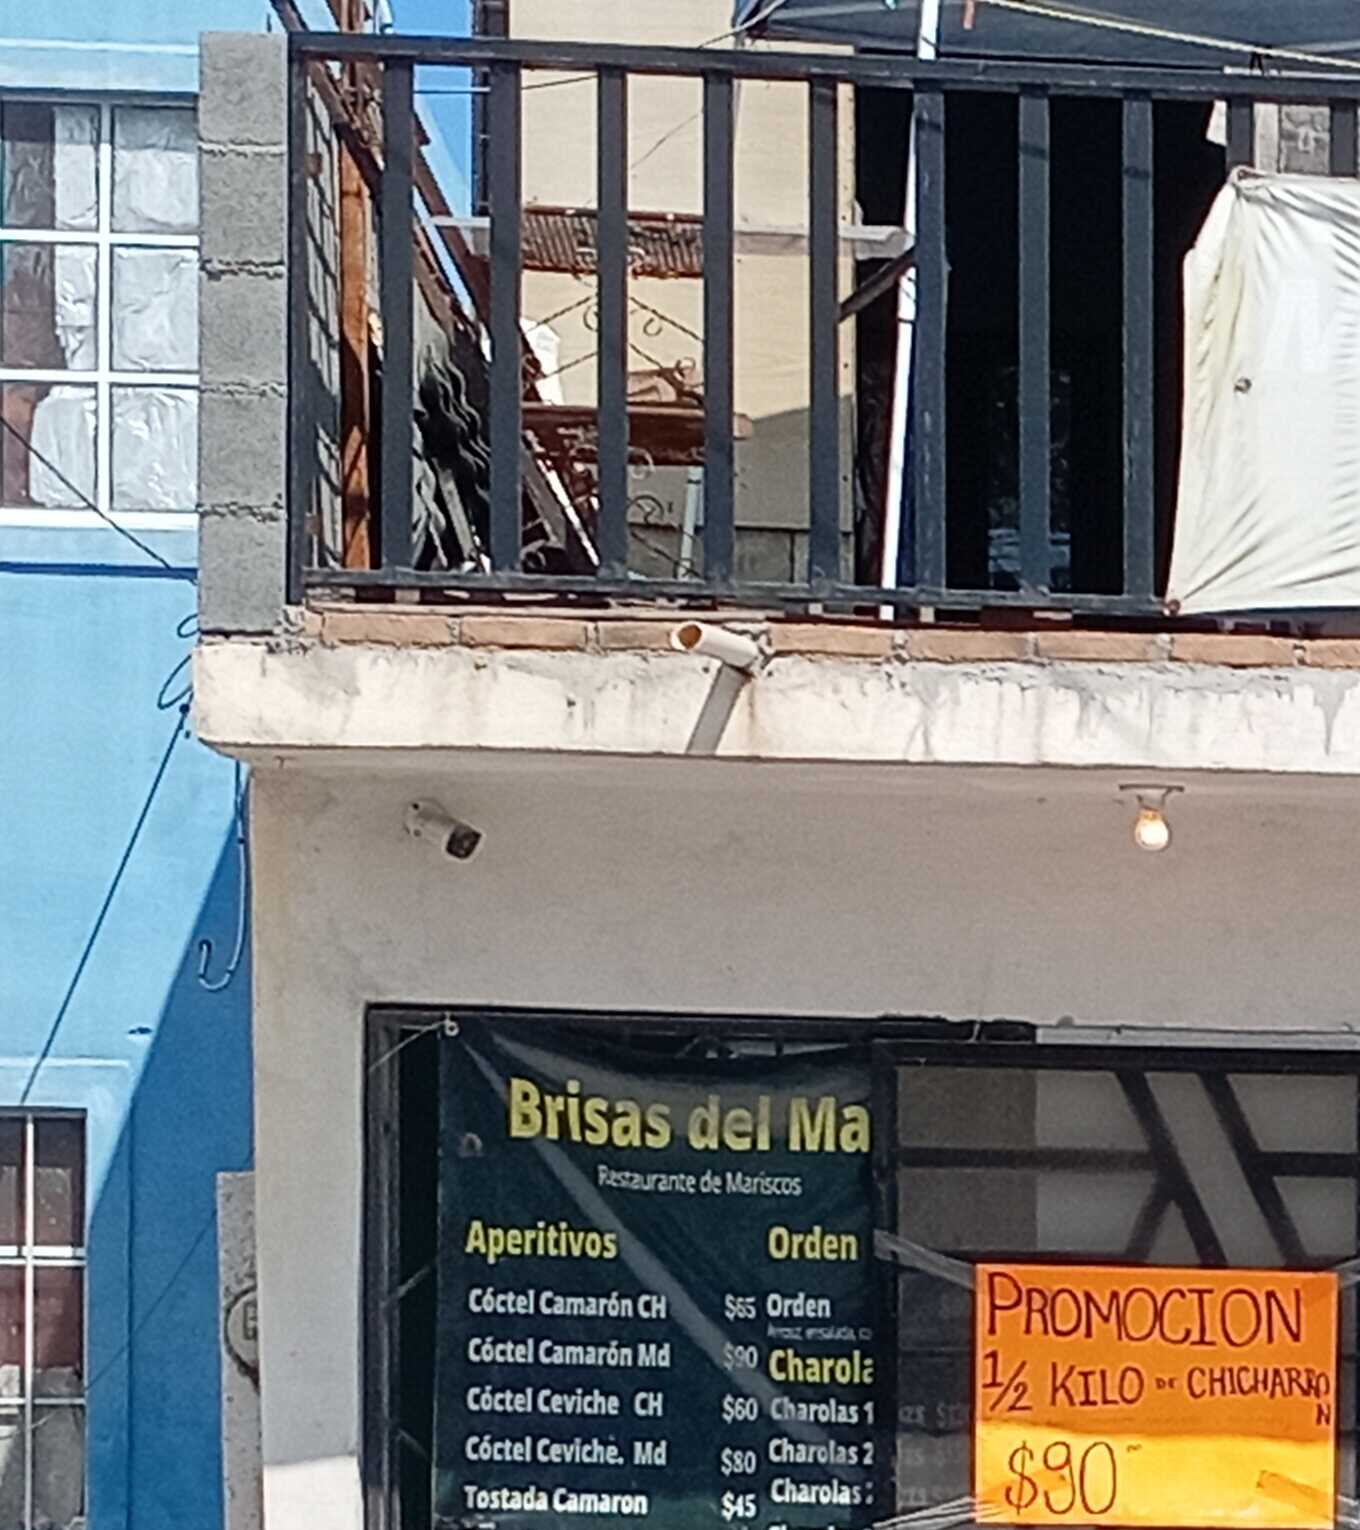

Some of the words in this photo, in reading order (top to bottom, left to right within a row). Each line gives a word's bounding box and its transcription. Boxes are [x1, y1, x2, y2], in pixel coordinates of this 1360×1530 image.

[509, 1077, 671, 1147] Brisas
[688, 1094, 769, 1150] del
[599, 1165, 695, 1193] Restaurante
[700, 1168, 721, 1193] de
[727, 1170, 801, 1196] Mariscos
[466, 1221, 617, 1264] Aperitivos
[769, 1227, 857, 1260] Orden
[469, 1289, 534, 1315] Cóctel
[539, 1291, 633, 1318] Camarón
[638, 1295, 666, 1319] CH
[725, 1293, 756, 1321] $65
[766, 1292, 831, 1318] Orden
[988, 1272, 1300, 1347] PROMOCION
[469, 1338, 534, 1364] Cóctel
[539, 1341, 632, 1367] Camarón
[639, 1343, 670, 1368] Md
[722, 1341, 758, 1371] $90
[1050, 1362, 1144, 1407] KILO
[467, 1387, 533, 1414] Cóctel
[537, 1390, 619, 1415] Ceviche
[634, 1393, 663, 1417] CH
[722, 1394, 758, 1424] $60
[771, 1397, 858, 1423] Charolas
[466, 1437, 532, 1465] Cóctel
[634, 1441, 666, 1466] Md
[721, 1447, 757, 1476] $80
[768, 1438, 858, 1465] Charolas
[771, 1478, 861, 1504] Charolas
[1005, 1440, 1116, 1515] $90
[464, 1486, 548, 1510] Tostada
[554, 1489, 647, 1514] Camaron
[721, 1490, 757, 1521] $45
